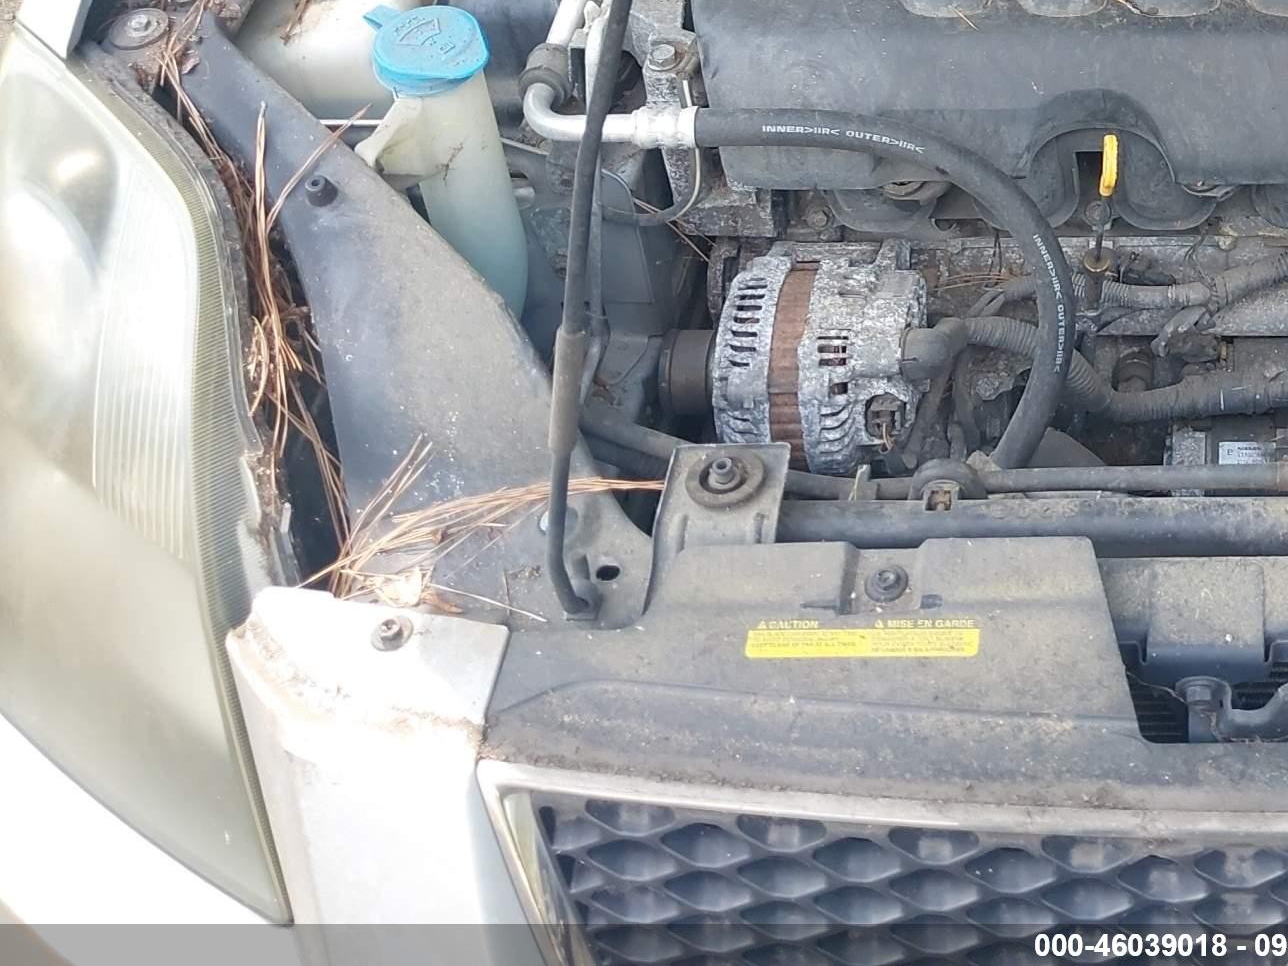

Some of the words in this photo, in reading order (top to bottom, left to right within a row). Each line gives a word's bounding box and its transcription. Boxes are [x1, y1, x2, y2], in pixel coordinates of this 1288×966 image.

[768, 620, 820, 629] CAUTION
[886, 619, 914, 628] MISE
[935, 619, 975, 628] GARDE
